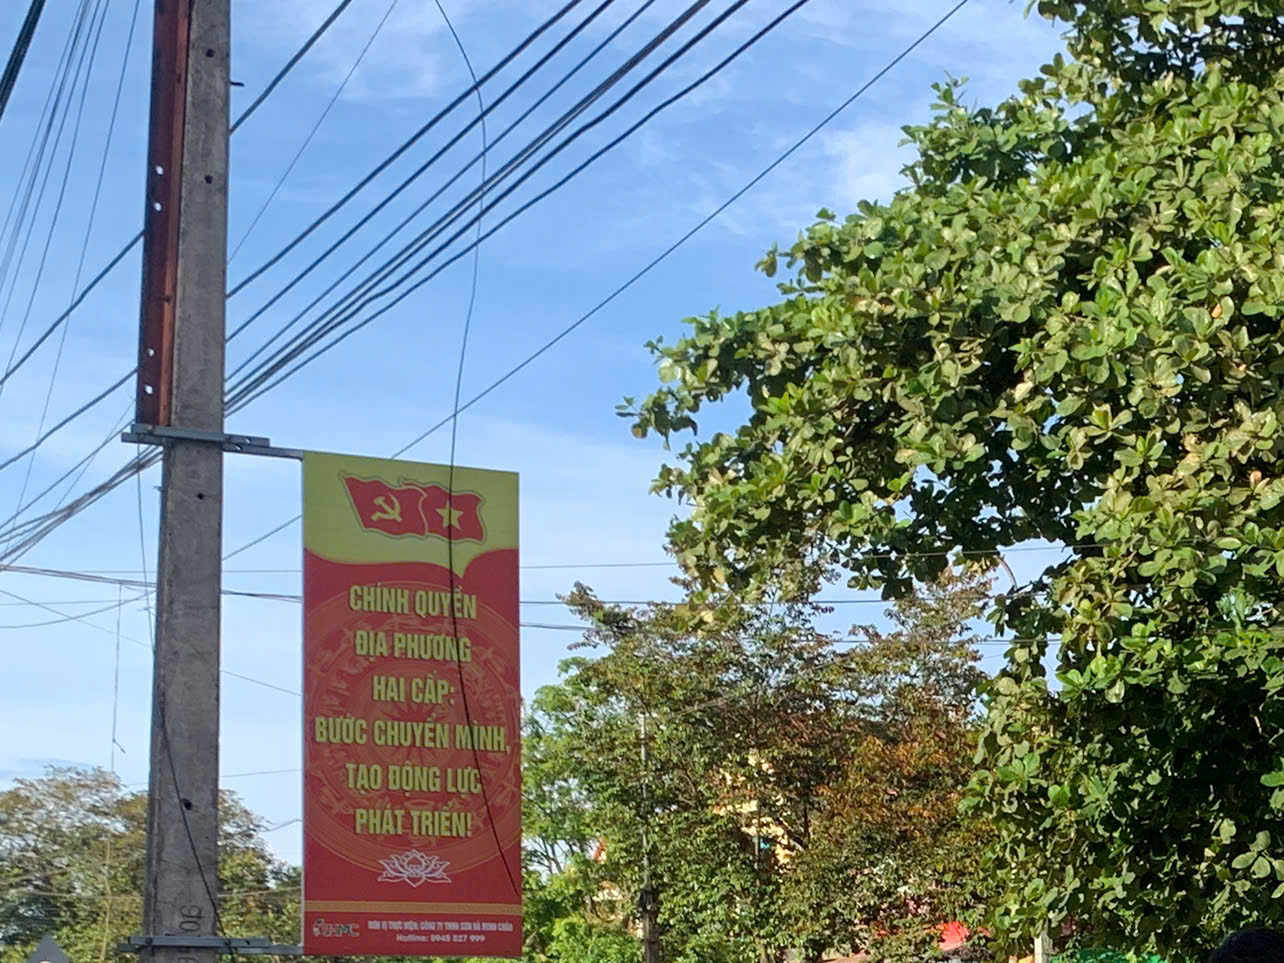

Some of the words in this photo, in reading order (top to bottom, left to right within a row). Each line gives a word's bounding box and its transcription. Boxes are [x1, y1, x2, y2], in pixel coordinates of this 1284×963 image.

[350, 583, 409, 614] CHÍNH
[415, 584, 477, 619] QUYỀN
[355, 631, 388, 662] ĐỊA
[394, 633, 472, 663] PHƯƠNG
[373, 674, 405, 701] HAI
[411, 670, 455, 705] CẤP:
[314, 715, 367, 745] BƯỚC
[374, 713, 449, 749] CHUYỂN
[346, 762, 382, 797] TẠO
[388, 761, 440, 798] ĐỘNG
[446, 767, 482, 799] LỰC
[355, 807, 403, 835] PHÁT
